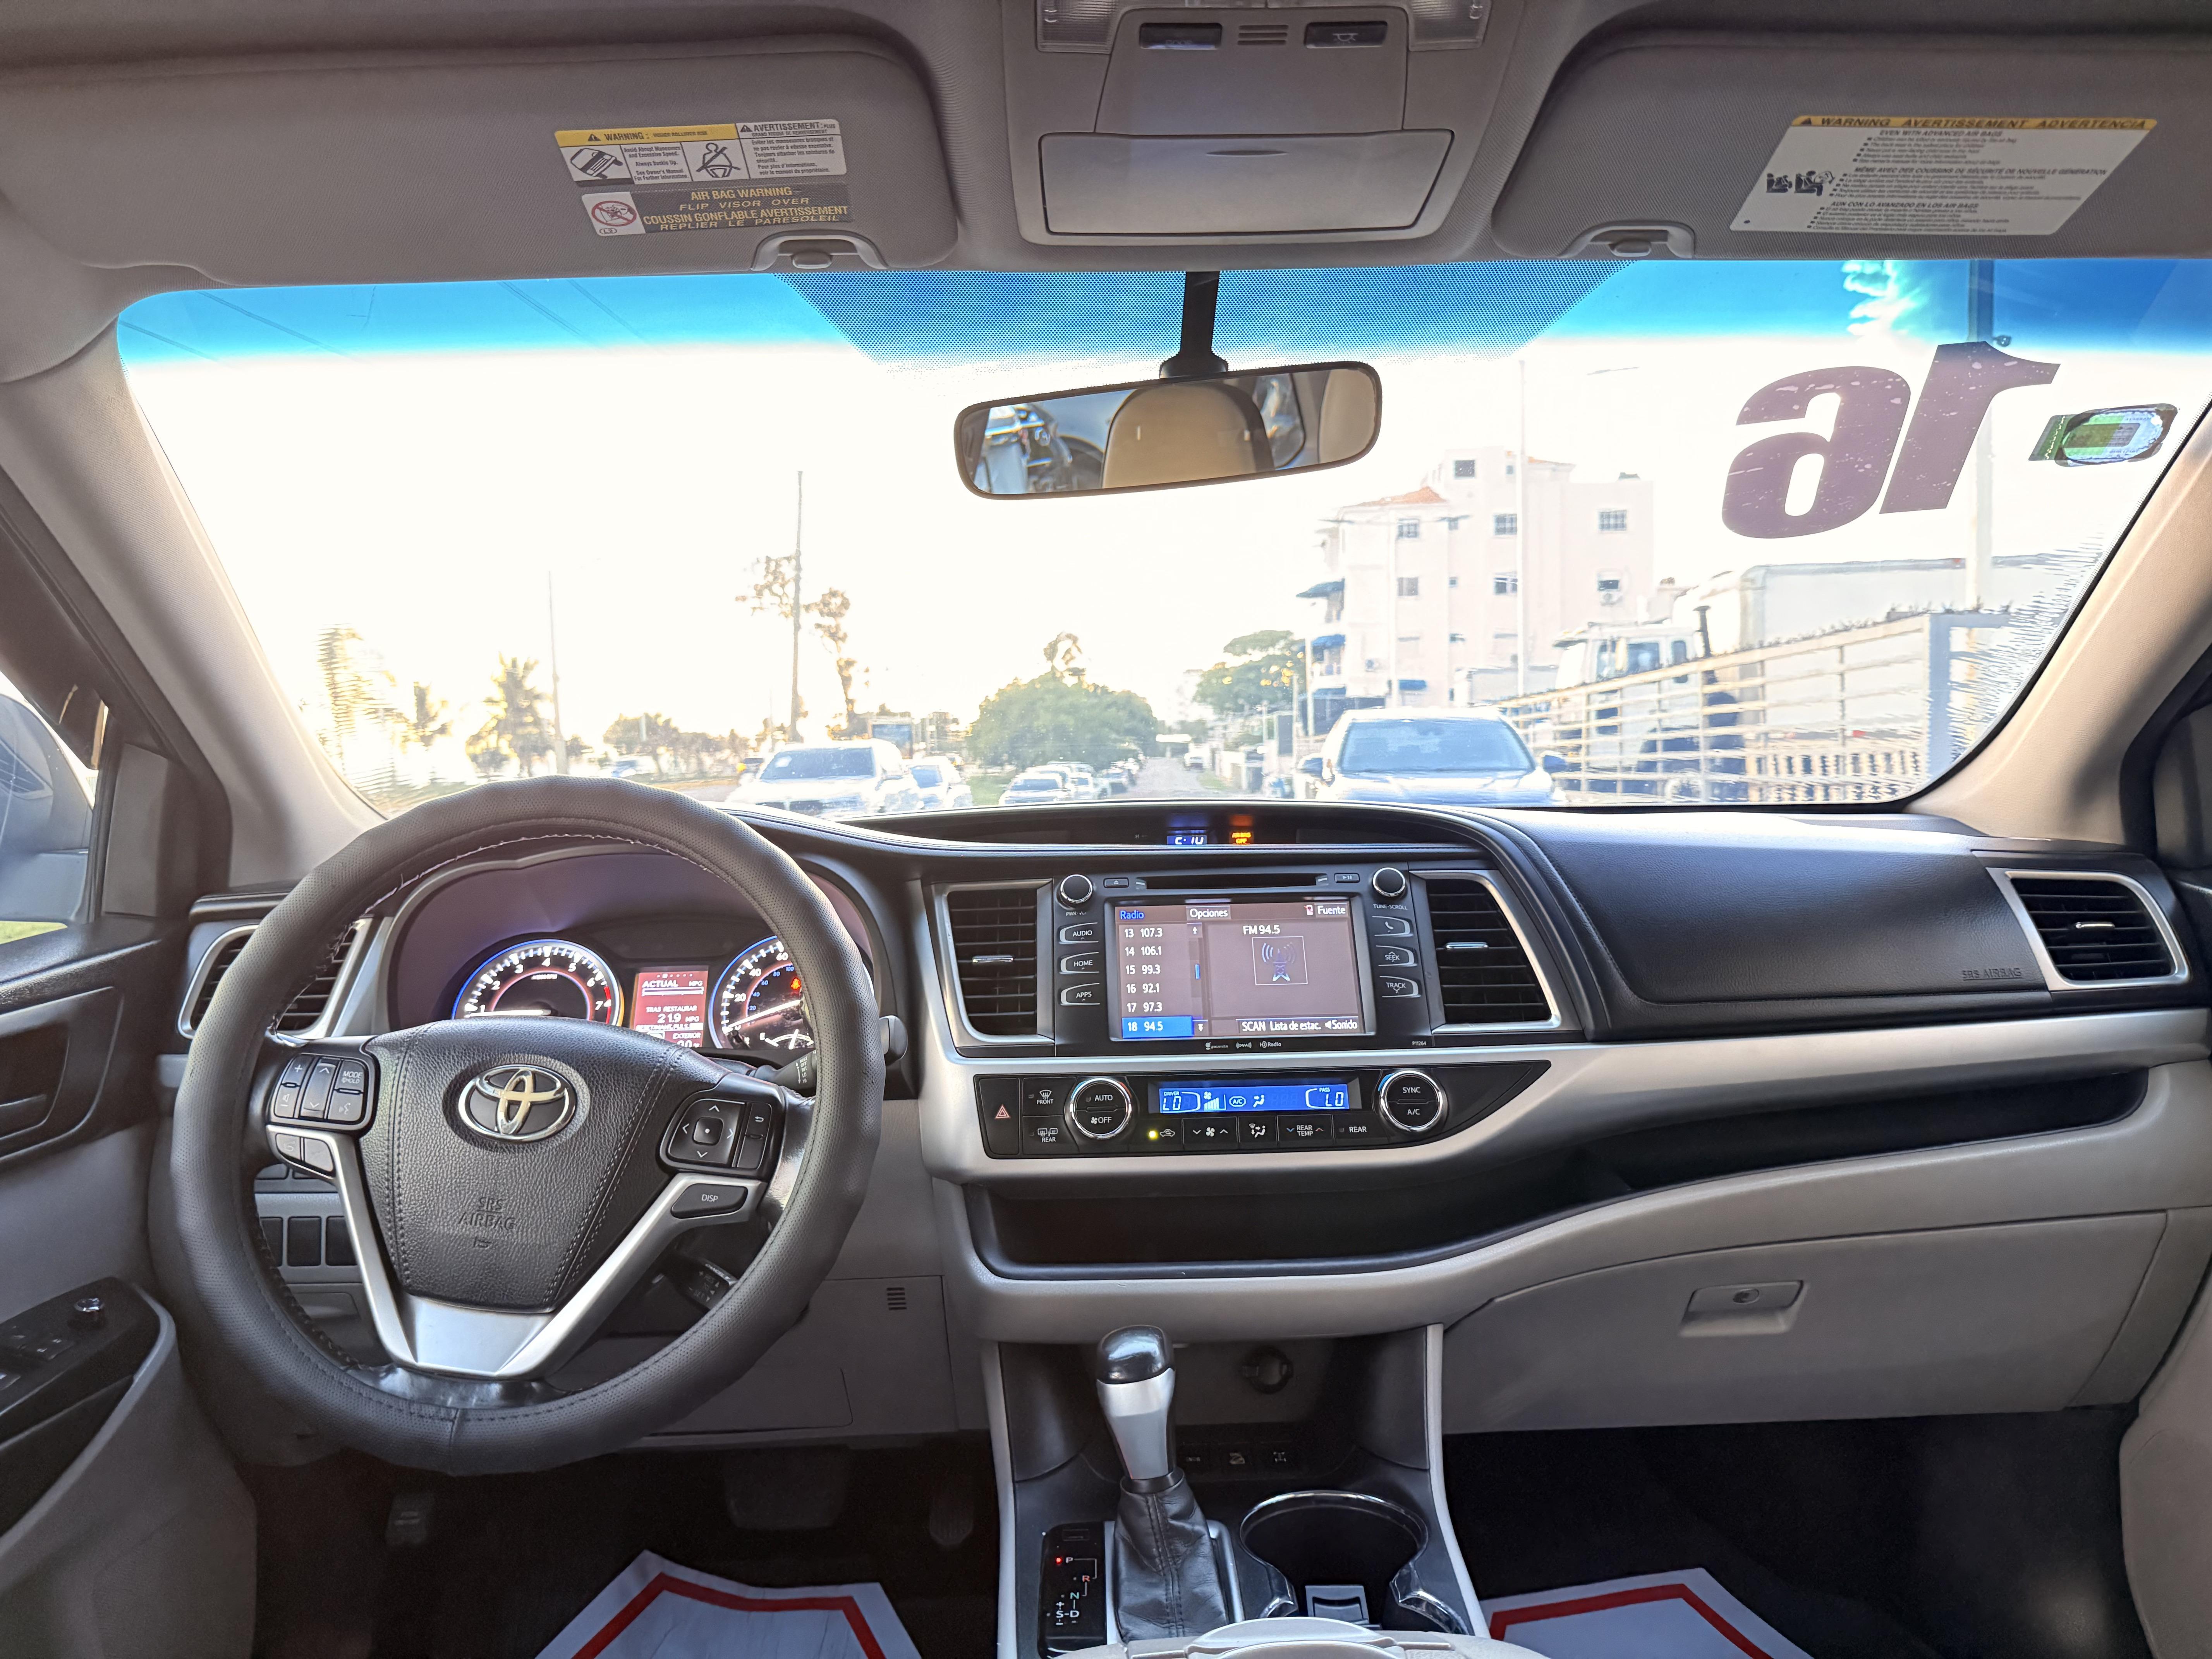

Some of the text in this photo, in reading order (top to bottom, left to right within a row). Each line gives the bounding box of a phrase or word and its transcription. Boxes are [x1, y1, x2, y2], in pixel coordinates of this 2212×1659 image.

[1821, 118, 2146, 129] WARNING AVERTISSEMENT ADVERTENCIA
[691, 187, 792, 201] AIR BAG WARNING
[680, 203, 708, 211] FLIP
[720, 201, 761, 209] VISOR
[644, 206, 848, 225] COUSSIN GONFLABLE AVERTISSEMENT
[660, 214, 840, 231] REPLIER LE PARESOLEIL
[1120, 910, 1144, 920] Radio
[1189, 906, 1346, 919] Opciones Fuente
[1124, 927, 1163, 938] 13 107.3
[1243, 924, 1280, 934] FM 94.5
[1125, 946, 1161, 956] 14 106.1
[776, 952, 789, 961] 60
[542, 957, 551, 967] 4
[514, 964, 524, 974] 3
[568, 963, 577, 972] 5
[749, 968, 762, 977] 40
[1126, 964, 1161, 975] 15 99.3
[1962, 968, 2022, 979] SRS AIRBAG
[491, 980, 501, 990] 2
[586, 977, 595, 987] 6
[641, 980, 679, 988] ACTUAL
[1126, 983, 1160, 993] 16 92.1
[734, 993, 747, 1002] 20
[479, 1005, 486, 1013] 1
[595, 1001, 603, 1011] 7
[1127, 1002, 1163, 1012] 17 97.3
[657, 1013, 681, 1023] 21.9
[1128, 1021, 1163, 1032] 18 94.5
[1242, 1020, 1357, 1032] SCAN Lista de estac. Sonido
[1163, 1095, 1182, 1111] LO
[1326, 1091, 1344, 1107] LO
[701, 1194, 718, 1202] DISP
[478, 1197, 505, 1211] SRS
[458, 1212, 517, 1231] AIRBAG
[1056, 1610, 1064, 1618] S
